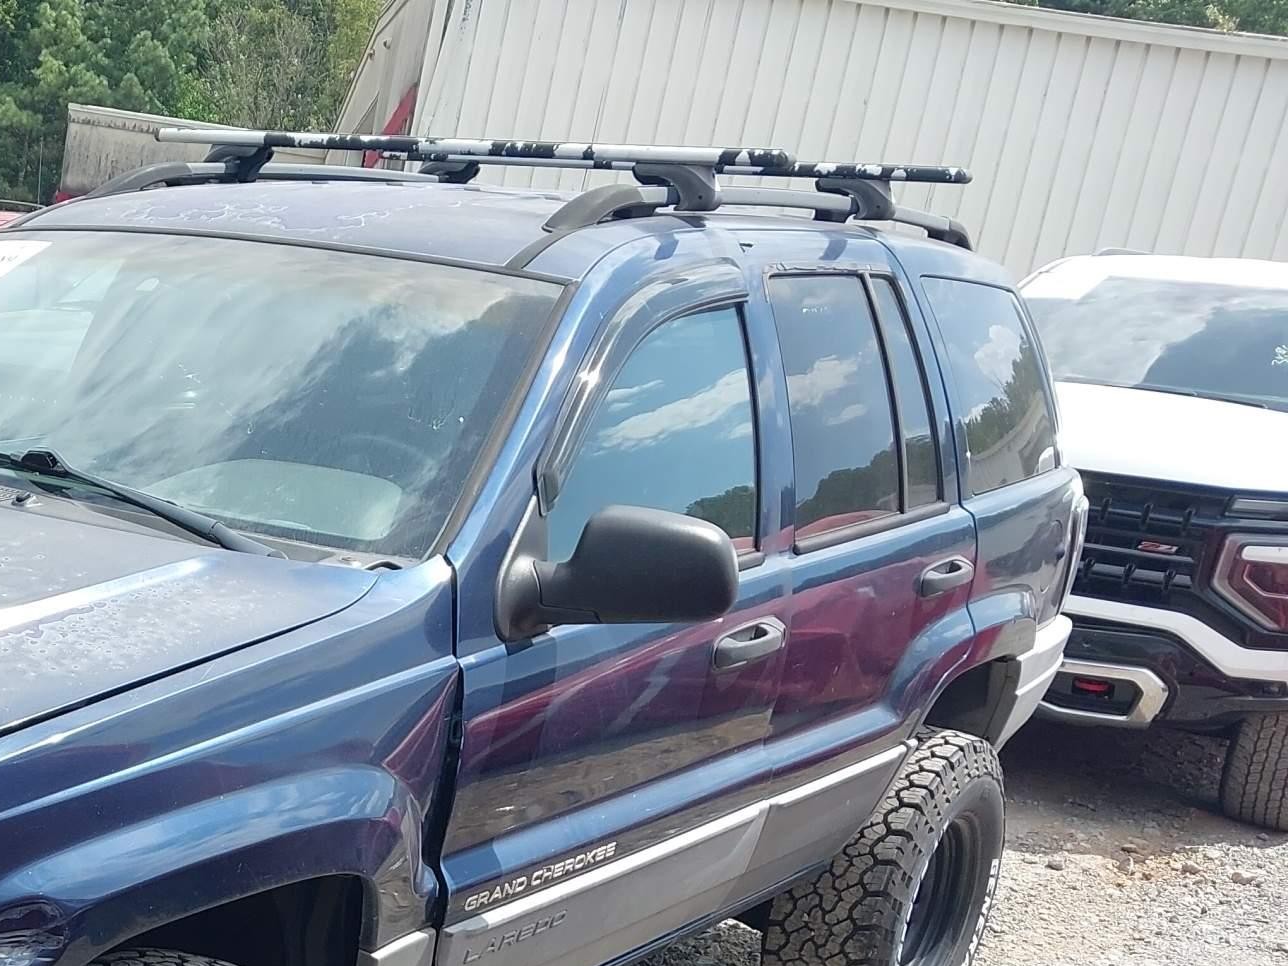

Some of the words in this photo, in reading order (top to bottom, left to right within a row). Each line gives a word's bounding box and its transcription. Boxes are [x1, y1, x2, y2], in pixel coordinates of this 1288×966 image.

[464, 876, 528, 912] GRAND
[531, 841, 617, 887] CHEROKEE
[463, 909, 569, 965] LAREDO
